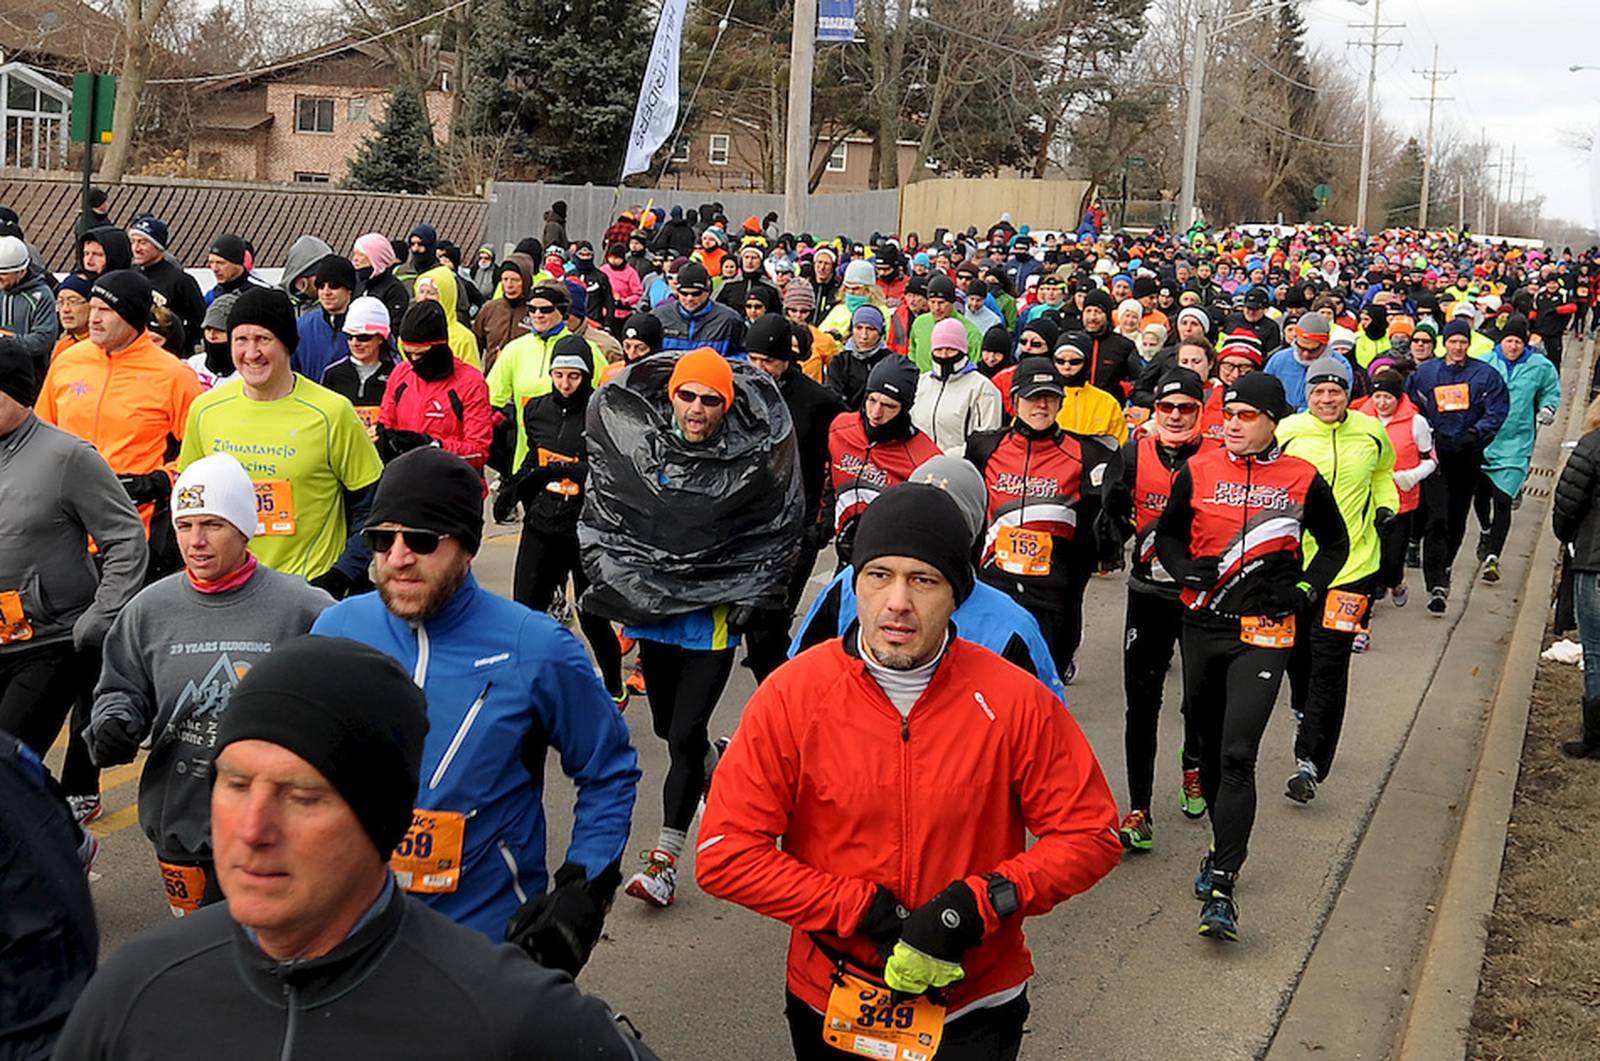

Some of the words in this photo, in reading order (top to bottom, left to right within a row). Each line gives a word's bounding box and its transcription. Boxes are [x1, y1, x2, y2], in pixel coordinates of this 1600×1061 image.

[213, 439, 297, 459] Zihuatanejo
[184, 641, 219, 655] YEARS
[218, 641, 272, 653] RUNNING
[856, 1003, 914, 1029] 349
